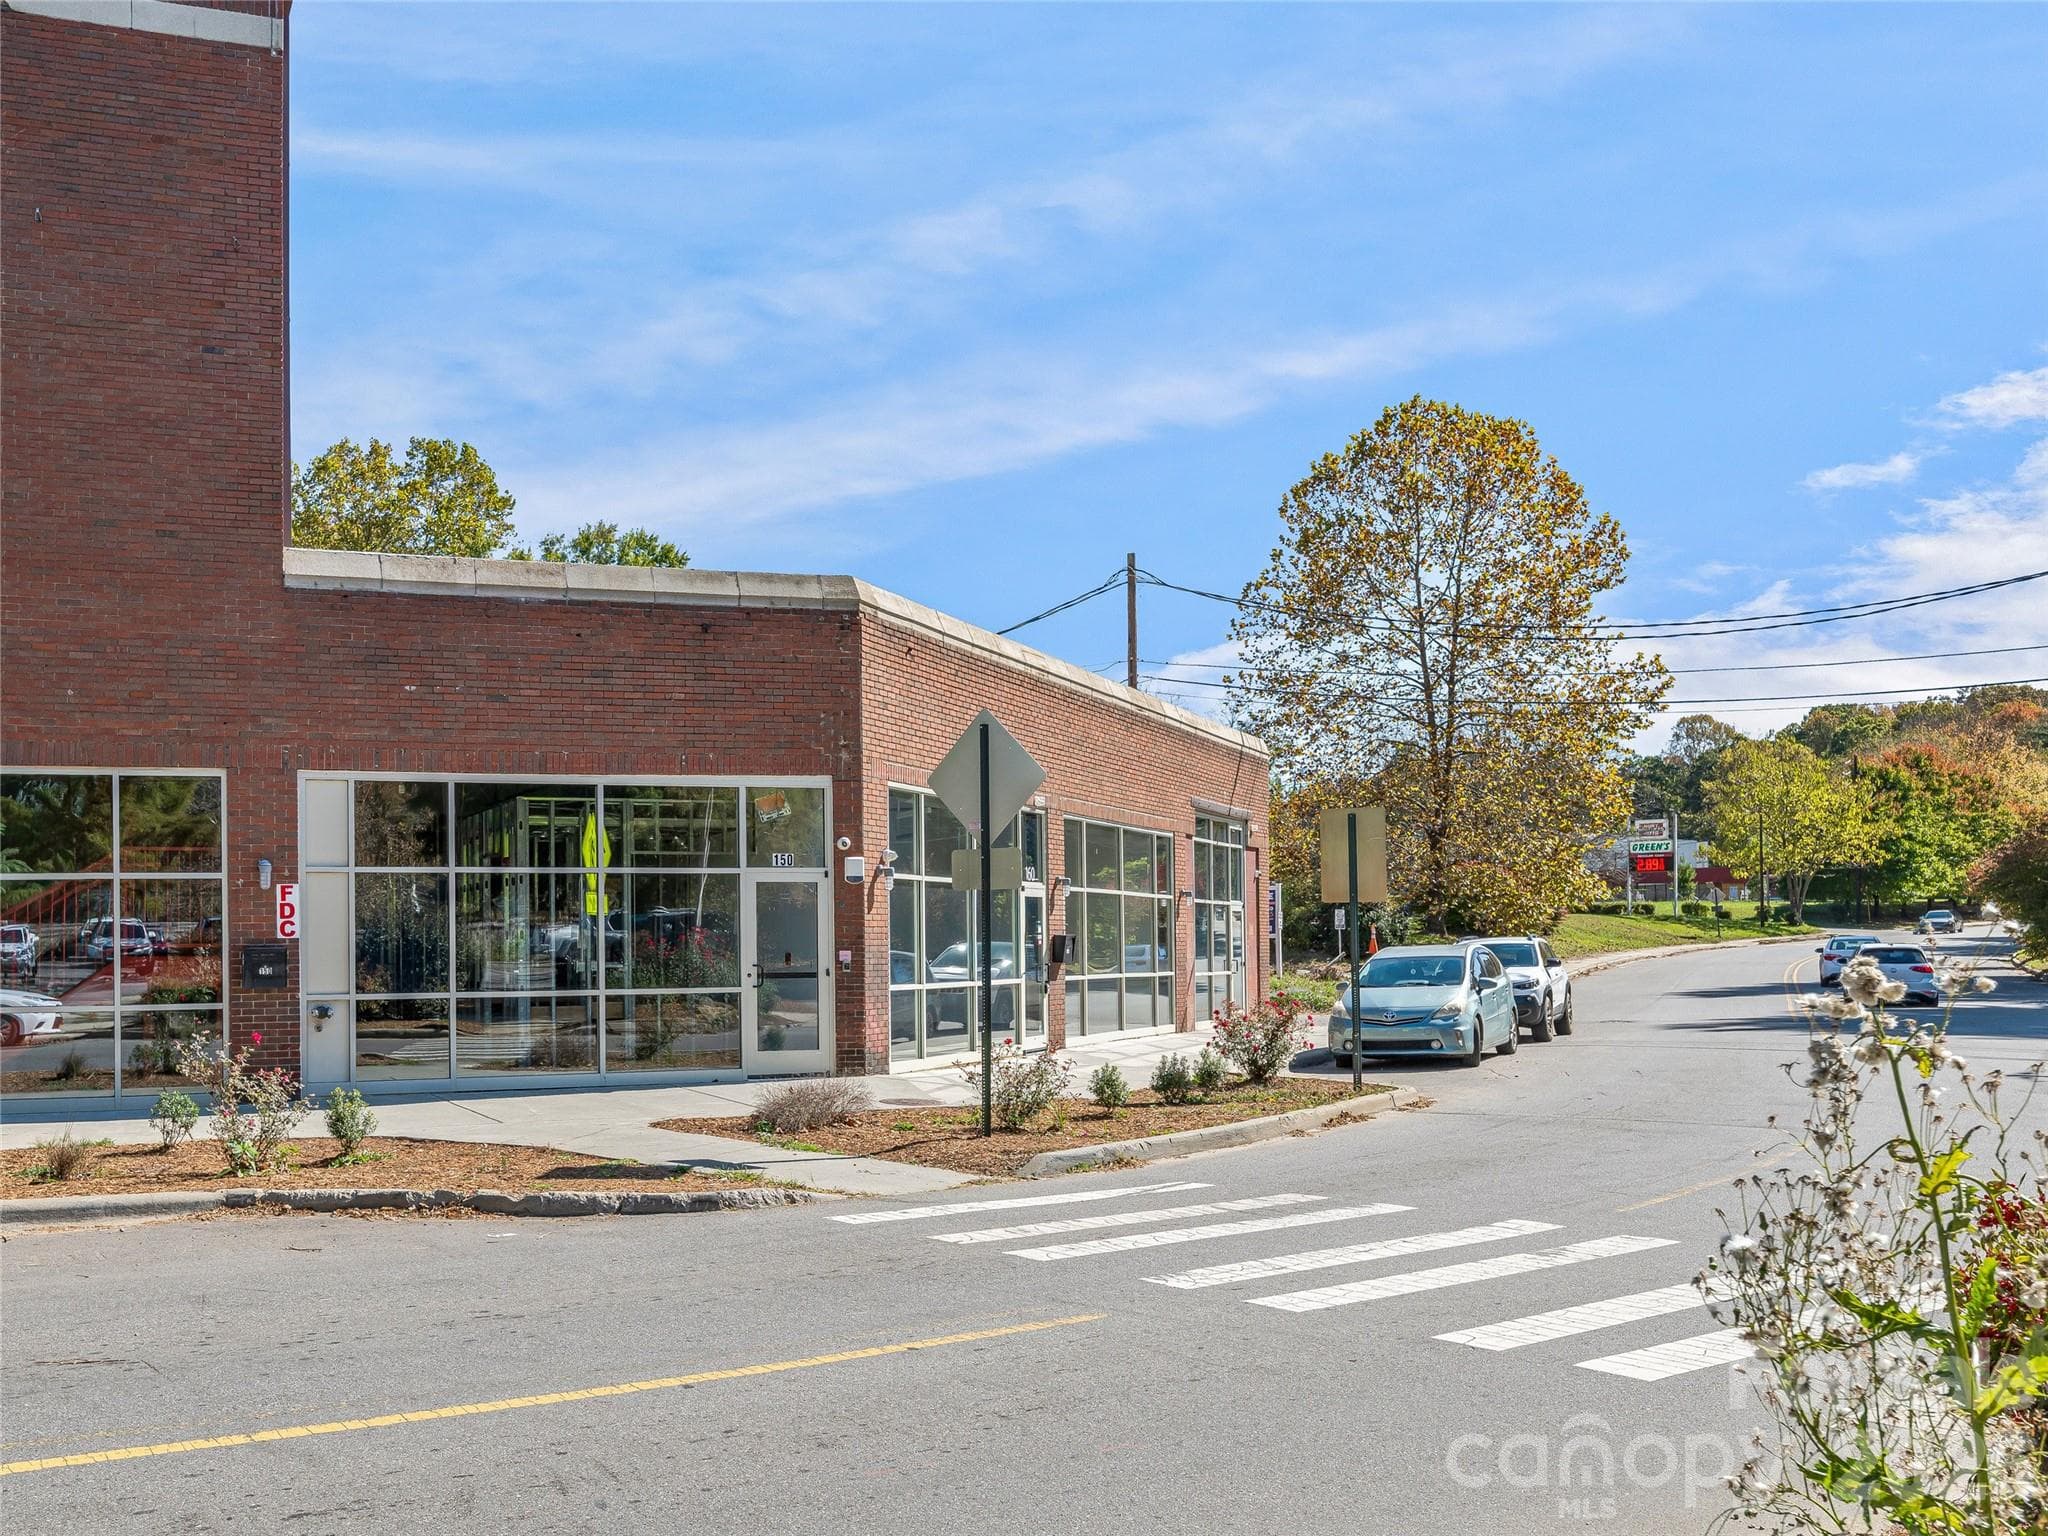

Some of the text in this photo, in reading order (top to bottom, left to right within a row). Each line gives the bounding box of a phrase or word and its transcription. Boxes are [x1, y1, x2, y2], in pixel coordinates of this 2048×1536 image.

[1632, 842, 1670, 852] GREEN'S
[774, 854, 793, 866] 150
[1025, 866, 1035, 881] 160
[280, 885, 296, 937] FDC
